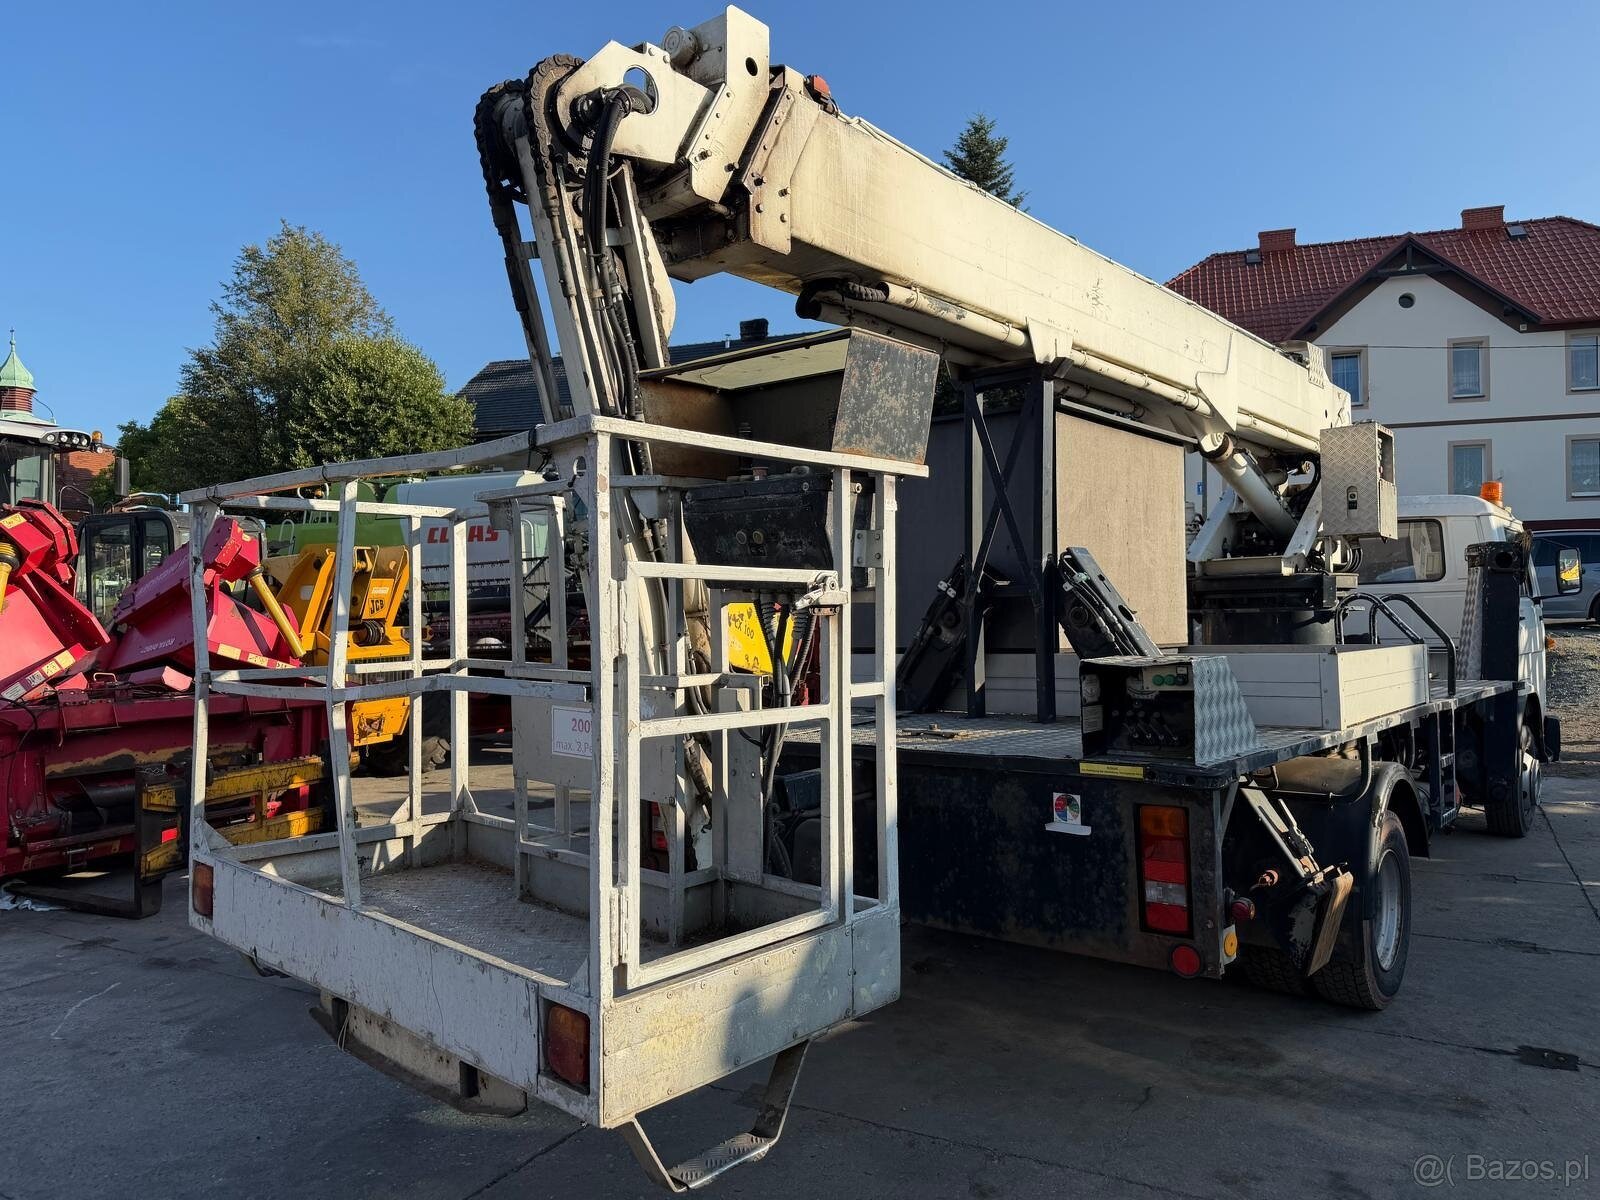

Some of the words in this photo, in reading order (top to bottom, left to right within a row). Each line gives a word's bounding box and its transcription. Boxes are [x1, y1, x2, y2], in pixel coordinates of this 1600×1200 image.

[427, 525, 500, 543] CLAS
[370, 599, 385, 614] JCB
[571, 718, 593, 734] 200
